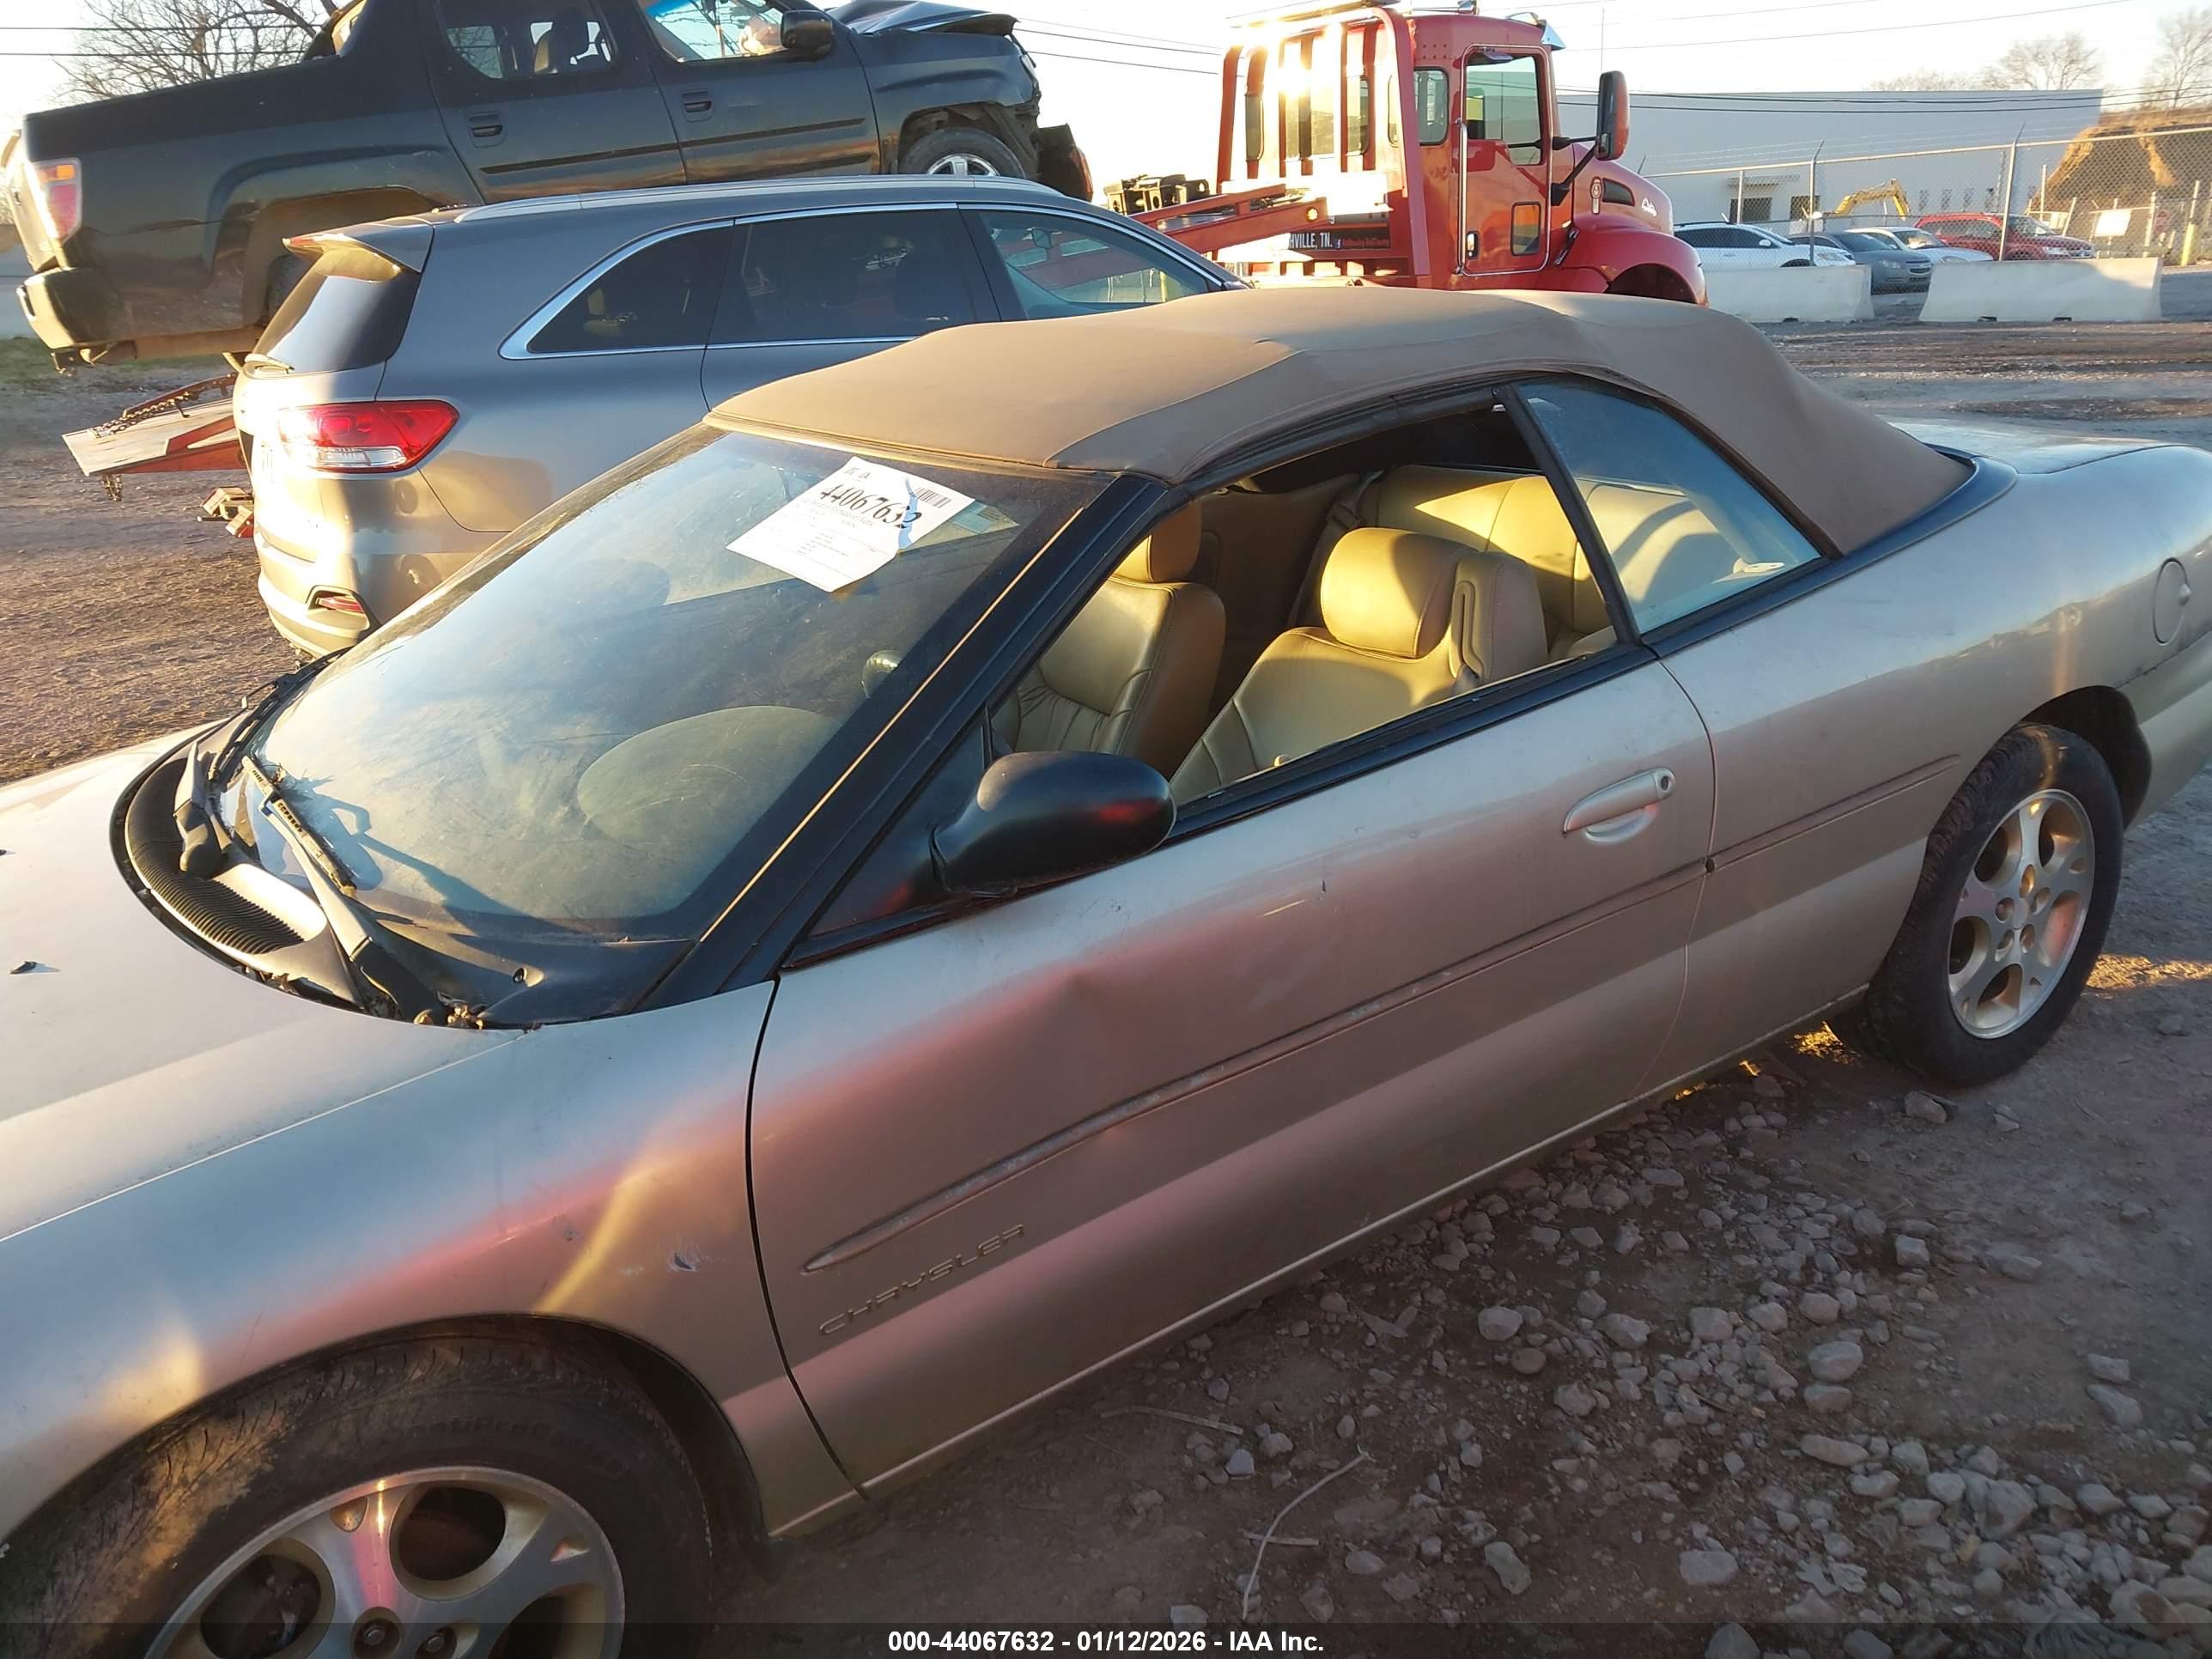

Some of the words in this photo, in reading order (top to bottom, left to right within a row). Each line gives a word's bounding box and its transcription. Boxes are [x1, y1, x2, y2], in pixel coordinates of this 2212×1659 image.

[1319, 232, 1333, 248] TN.
[819, 483, 922, 529] 44067632
[817, 1224, 1024, 1335] CHRYSLER
